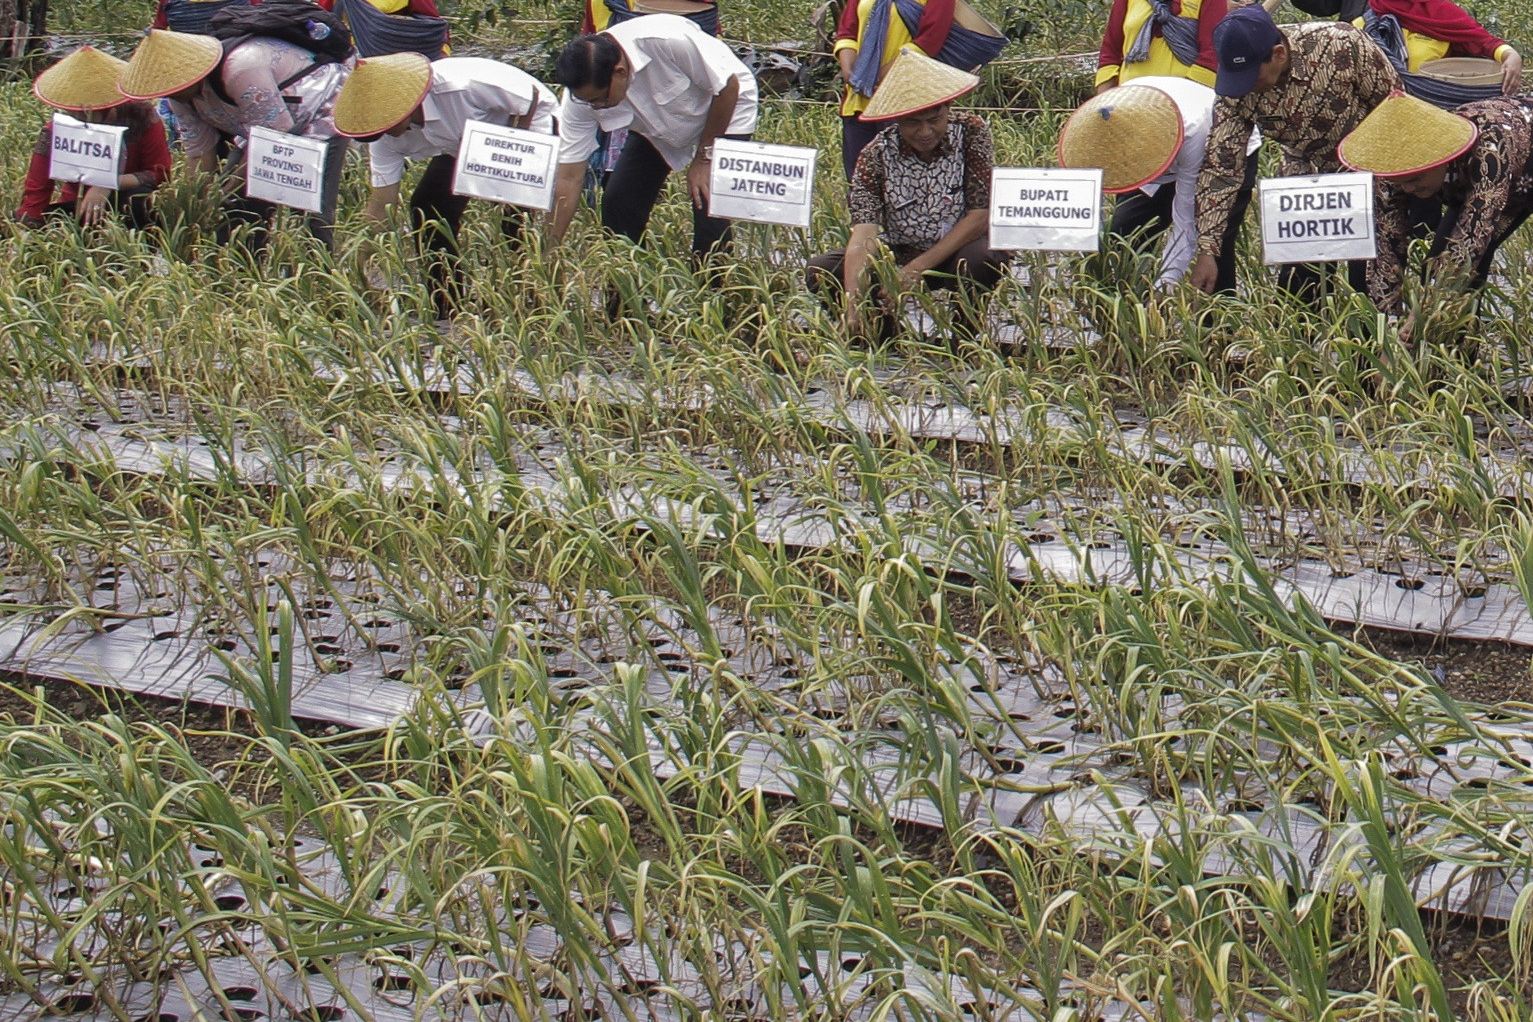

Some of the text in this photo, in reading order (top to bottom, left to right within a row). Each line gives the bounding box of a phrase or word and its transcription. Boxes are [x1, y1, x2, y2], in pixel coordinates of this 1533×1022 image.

[54, 135, 112, 160] BALITSA
[273, 144, 295, 158] BPTP
[484, 137, 536, 155] DIREKTUR
[262, 156, 304, 174] PROVINSI
[490, 152, 523, 167] BENIH
[718, 156, 804, 179] DISTANBUN
[253, 166, 312, 189] JAWA TENGAH
[466, 162, 544, 185] HORTIKULTURA
[730, 177, 787, 197] JATENG
[1019, 189, 1069, 202] BUPATI
[1279, 191, 1352, 212] DIRJEN
[998, 205, 1091, 220] TEMANGGUNG
[1277, 217, 1355, 238] HORTIK
